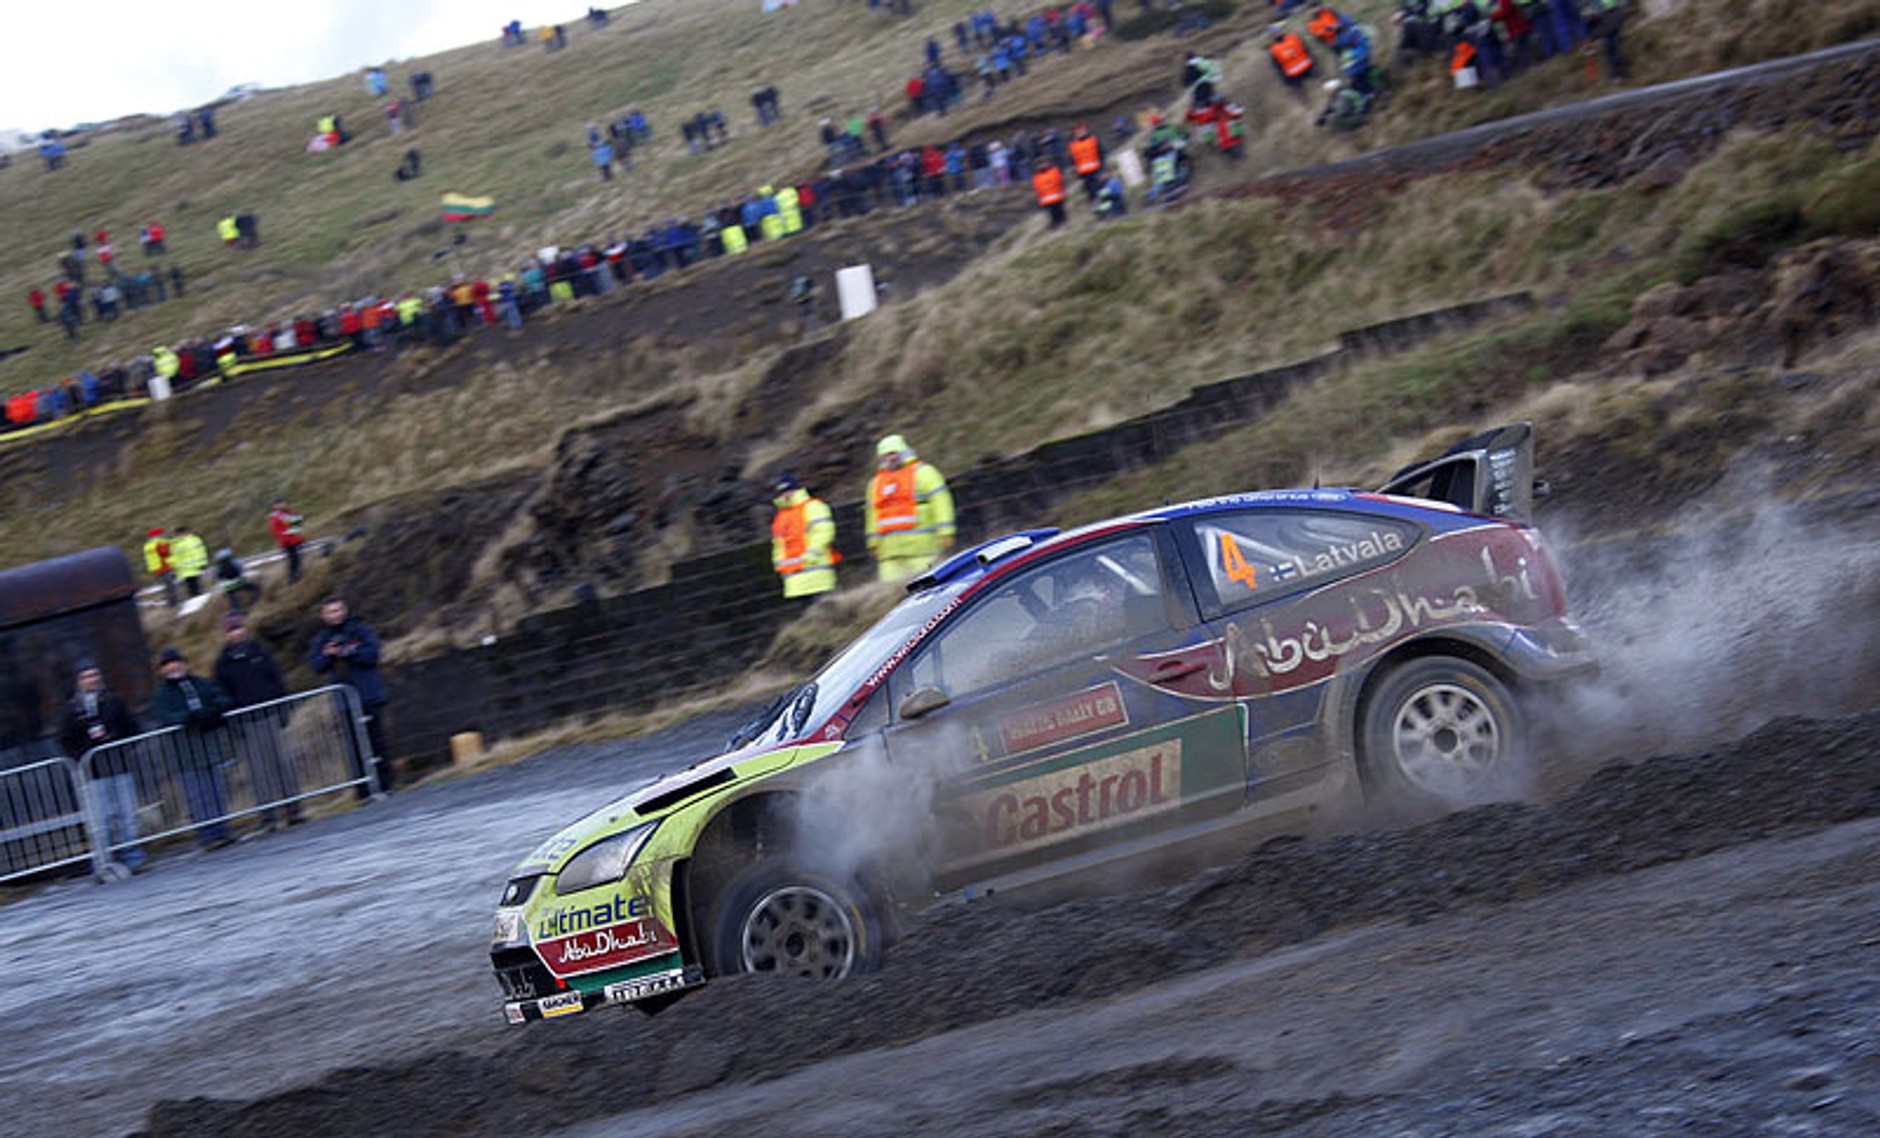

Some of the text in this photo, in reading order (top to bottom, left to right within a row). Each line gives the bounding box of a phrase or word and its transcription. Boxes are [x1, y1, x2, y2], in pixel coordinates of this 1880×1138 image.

[1220, 530, 1403, 590] 4 Latvala
[985, 752, 1165, 847] Castrol
